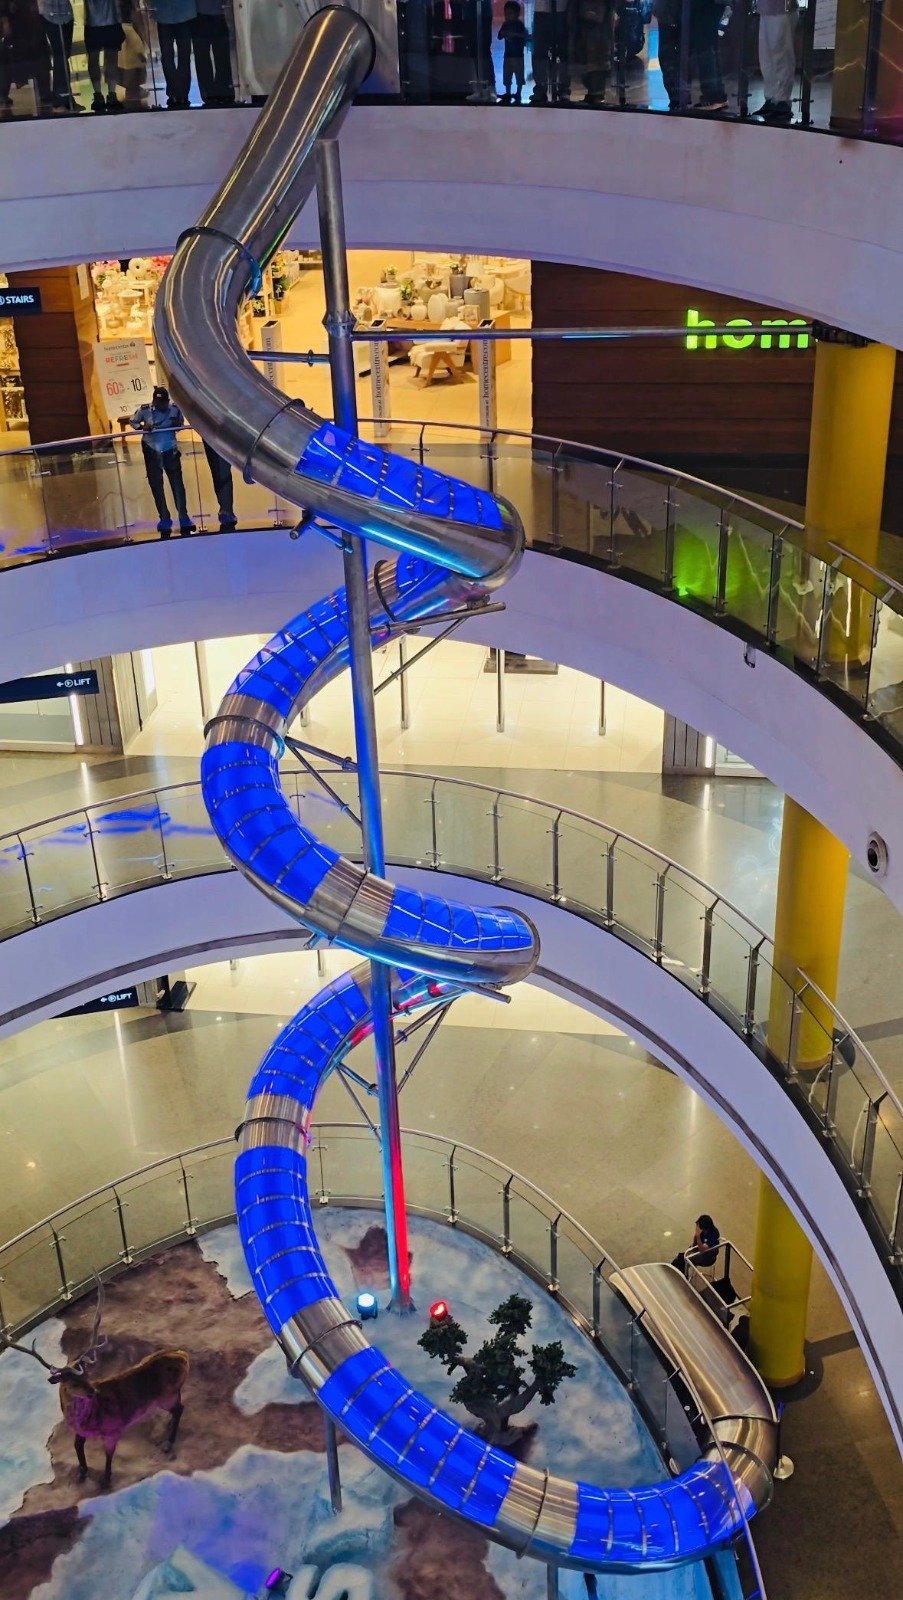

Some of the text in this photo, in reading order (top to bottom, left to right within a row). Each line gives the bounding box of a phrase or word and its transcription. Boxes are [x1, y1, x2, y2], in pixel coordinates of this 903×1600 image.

[5, 295, 34, 304] STAIRS
[74, 678, 91, 686] LIFT
[116, 993, 132, 1001] LIFT
